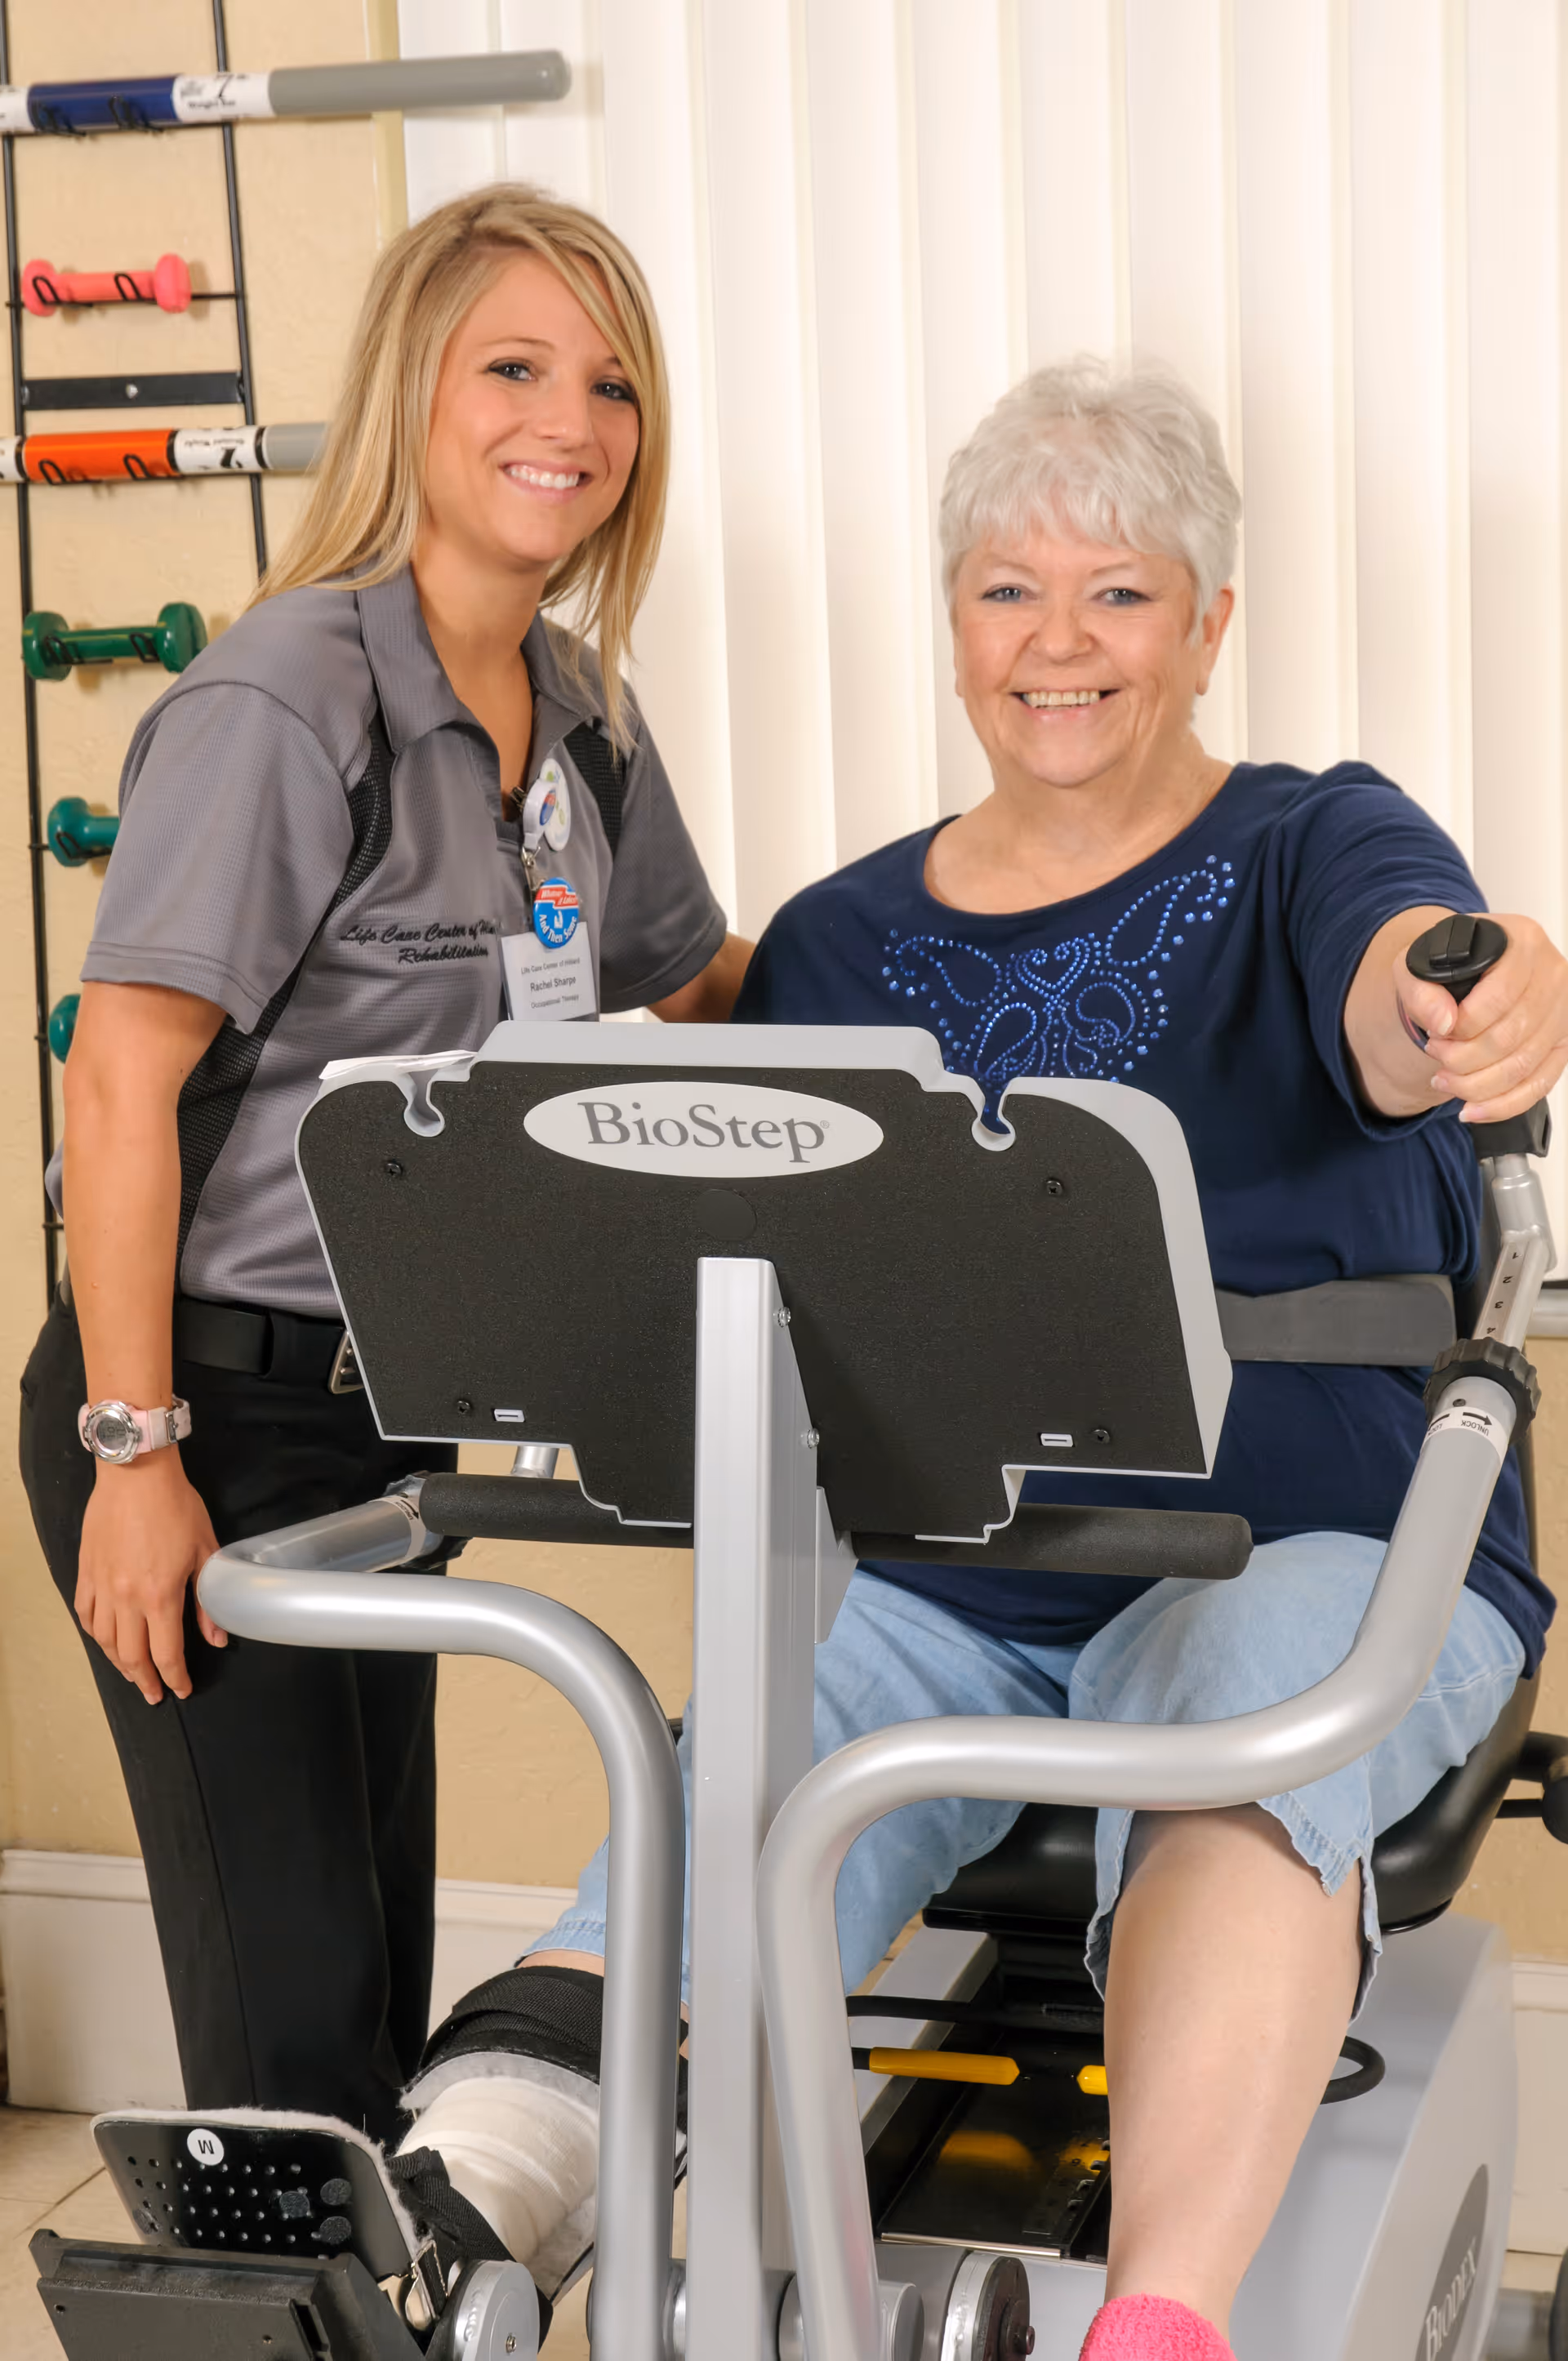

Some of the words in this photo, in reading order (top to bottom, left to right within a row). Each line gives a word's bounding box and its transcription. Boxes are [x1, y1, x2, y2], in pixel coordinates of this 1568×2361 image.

[341, 924, 376, 945] Life
[381, 924, 421, 944] Care
[424, 922, 466, 942] Center
[539, 914, 550, 935] And
[547, 928, 564, 944] Then
[564, 915, 577, 940] Some
[398, 943, 488, 964] Rehabilitation
[530, 979, 552, 991] Rachel
[554, 976, 577, 987] Sharpe
[577, 1101, 826, 1163] BioStep
[1503, 1276, 1513, 1284] 2
[1494, 1301, 1503, 1309] 3
[1460, 1419, 1490, 1437] UNLOCK
[1425, 2235, 1477, 2361] BIODEX
